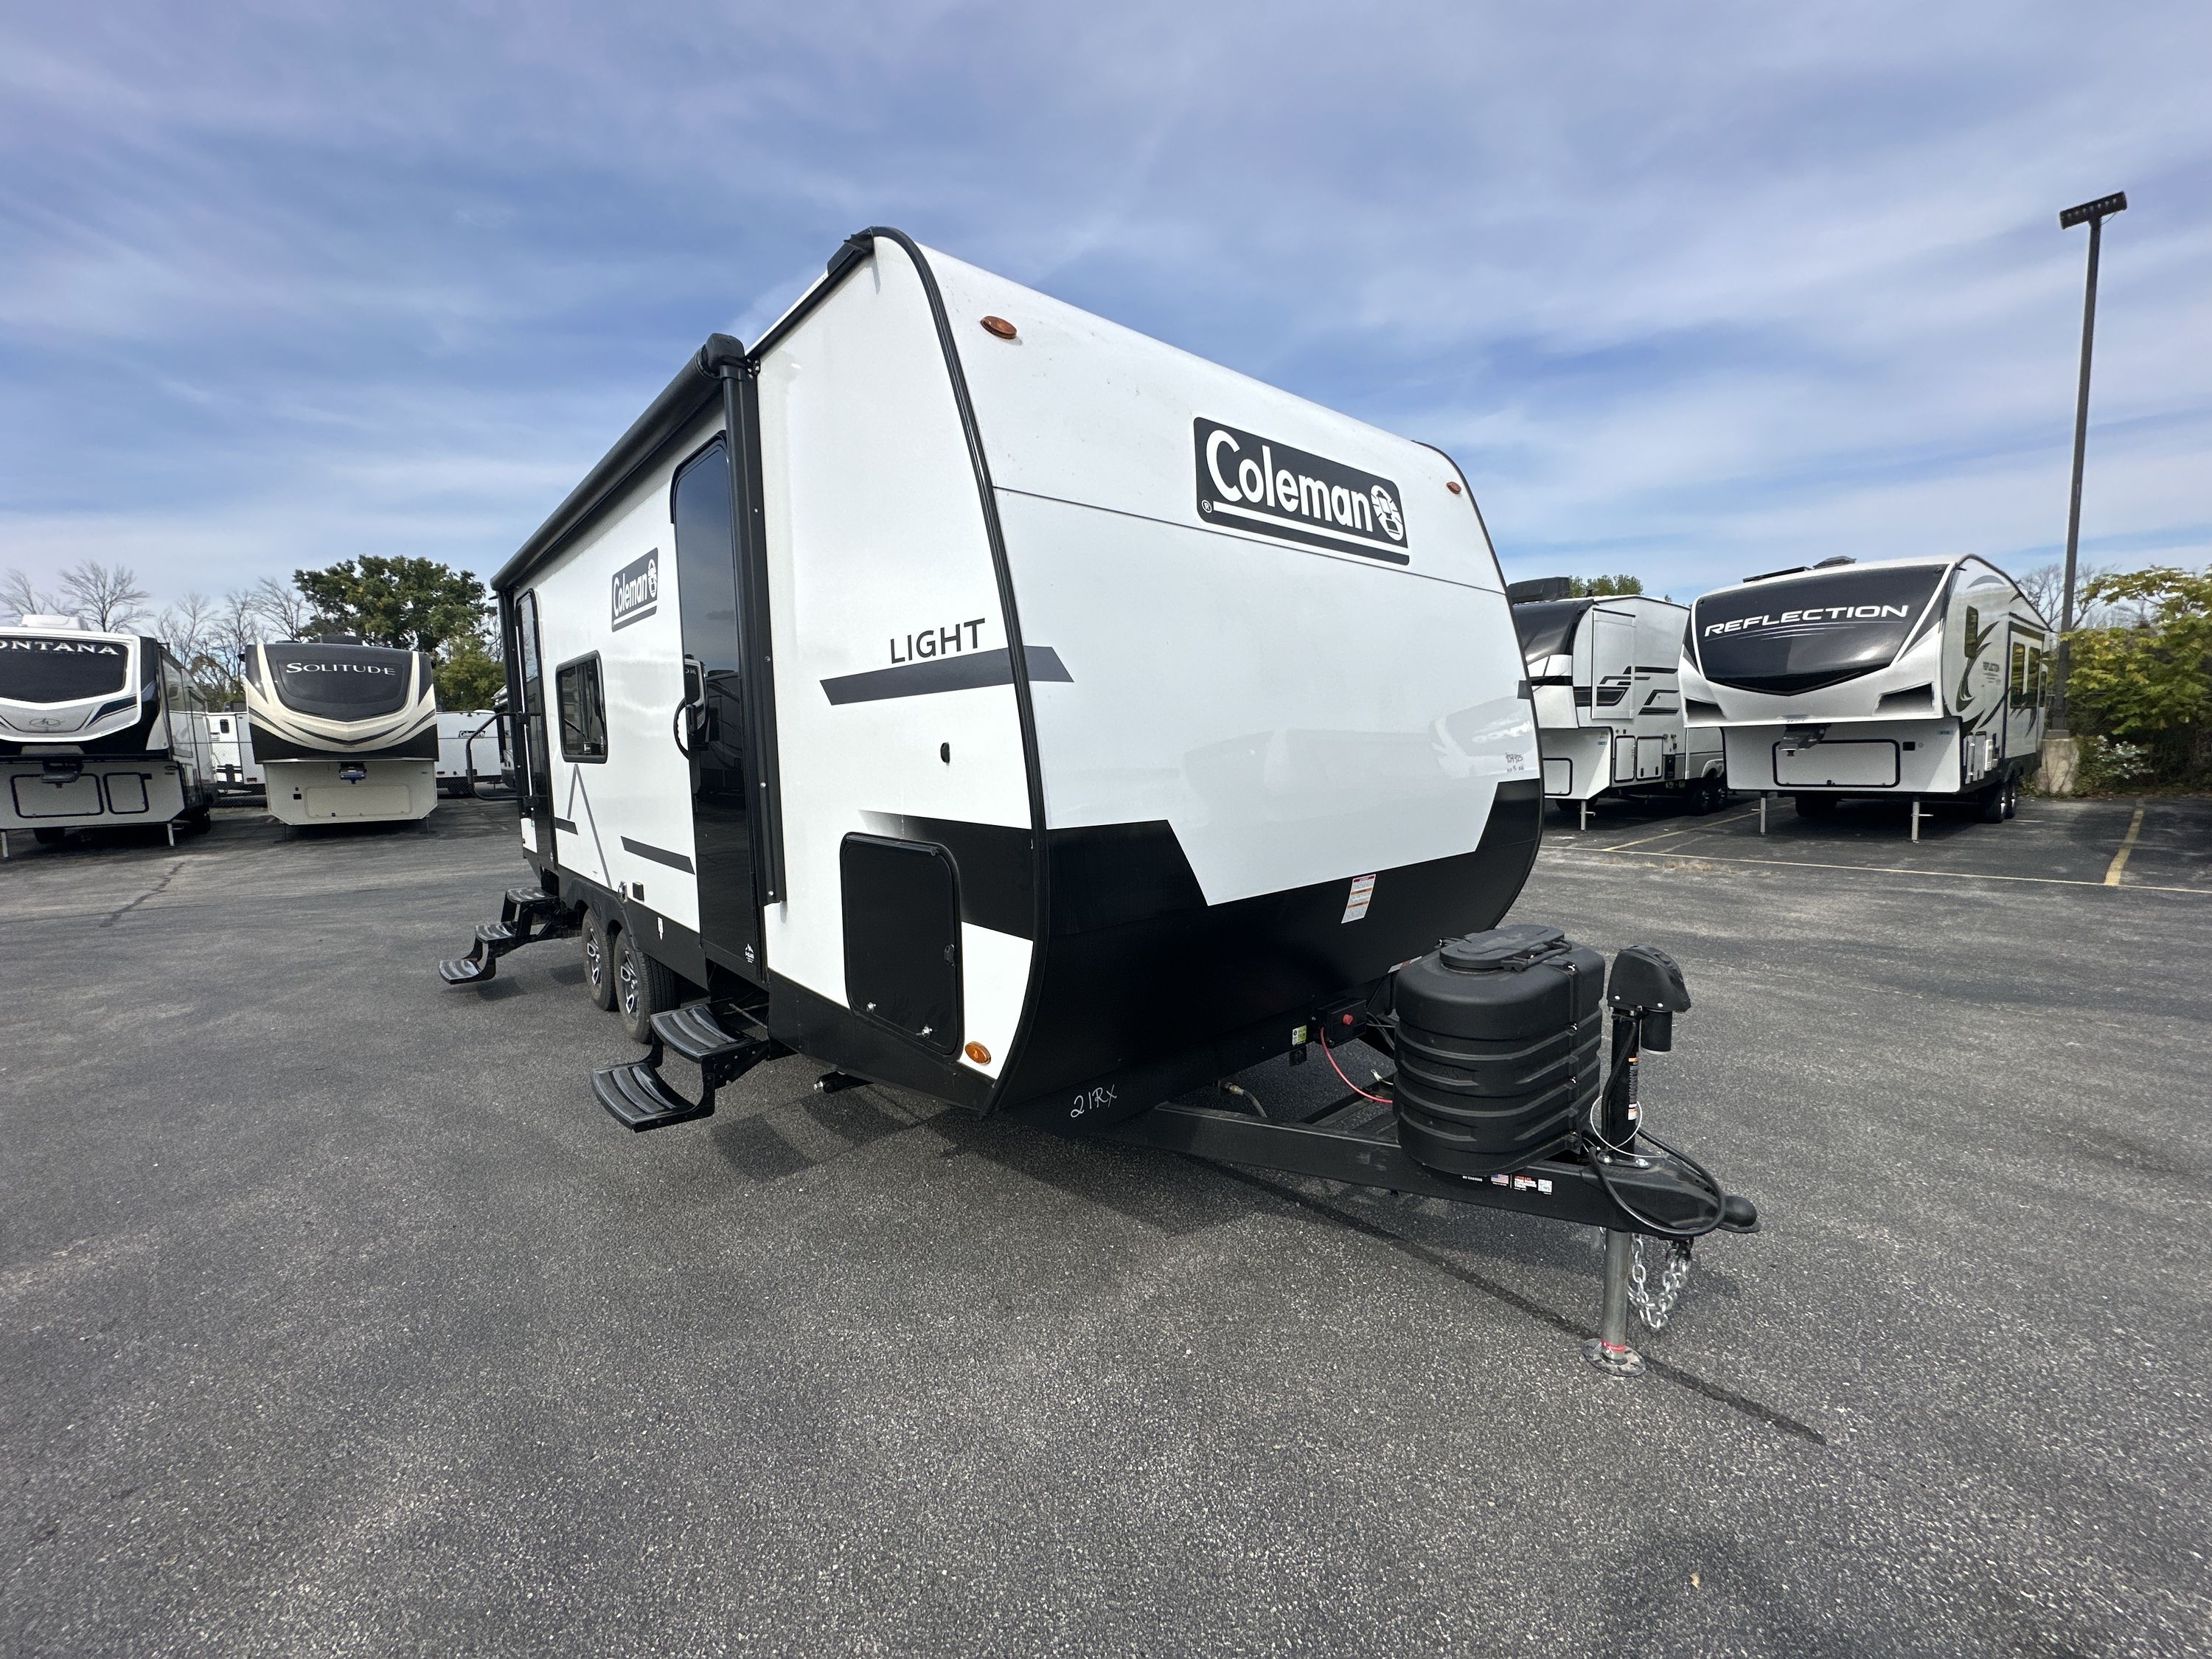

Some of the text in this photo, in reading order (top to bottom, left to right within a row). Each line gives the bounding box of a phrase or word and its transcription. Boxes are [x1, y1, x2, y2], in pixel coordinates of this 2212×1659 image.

[1206, 429, 1374, 532] Coleman
[613, 572, 648, 617] Coleman
[890, 617, 985, 664] LIGHT
[1704, 605, 1909, 637] REFLECTION
[286, 662, 396, 675] SOLITUDE
